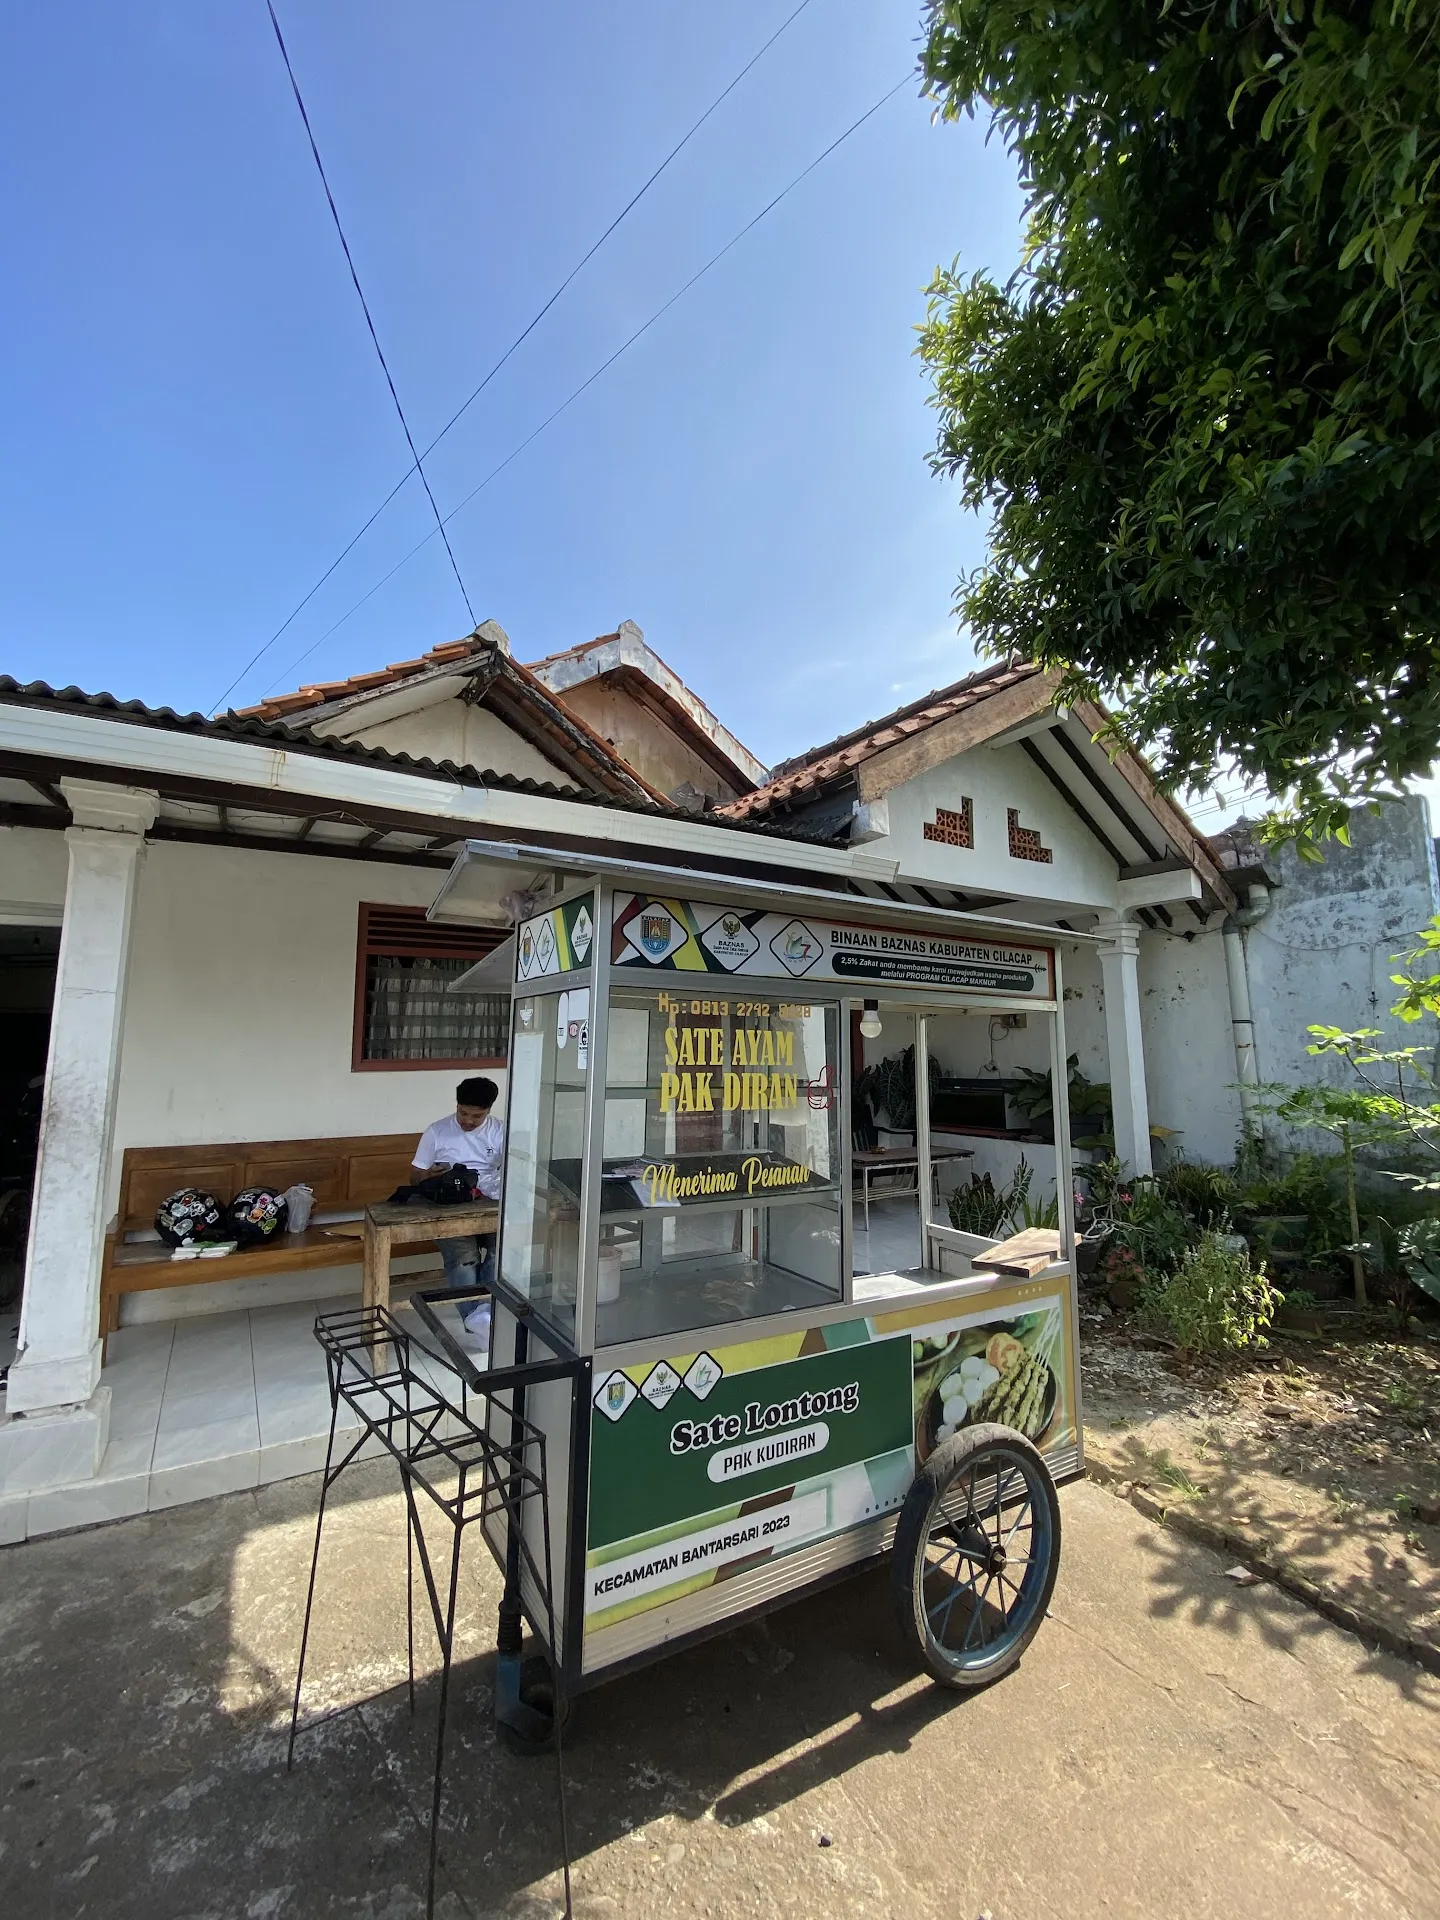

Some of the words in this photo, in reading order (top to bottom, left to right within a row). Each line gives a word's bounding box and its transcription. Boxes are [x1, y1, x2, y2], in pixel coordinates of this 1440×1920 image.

[718, 940, 745, 948] BAZNAS
[831, 930, 877, 948] BINAAN
[881, 936, 926, 953] BAZNAS
[929, 942, 990, 961] KABUPATEN
[993, 950, 1032, 965] CILACAP
[841, 956, 858, 966] 2,5%
[859, 958, 878, 968] Zakat
[880, 961, 896, 970] anda
[897, 963, 931, 973] membantu
[931, 964, 947, 974] kami
[984, 971, 1002, 980] usaha
[1002, 973, 1028, 983] produktif
[881, 969, 905, 979] melalui
[905, 971, 940, 982] PROGRAM
[941, 974, 969, 985] CILACAP
[969, 977, 997, 987] MAKMUR
[690, 1000, 729, 1016] 0813
[736, 1002, 770, 1017] 2742
[664, 1027, 724, 1066] SATE
[731, 1029, 794, 1066] AYAM
[659, 1072, 715, 1112] PAK
[722, 1072, 798, 1111] DIRAN
[641, 1164, 738, 1205] Menerima
[741, 1156, 810, 1195] Pesanan
[670, 1413, 741, 1455] Sate
[745, 1381, 859, 1435] Lontong
[723, 1451, 753, 1474] PAK
[756, 1432, 816, 1463] KUDIRAN
[594, 1555, 679, 1596] KECAMATAN
[681, 1526, 759, 1565] BANTARSARI
[762, 1515, 791, 1535] 2023
